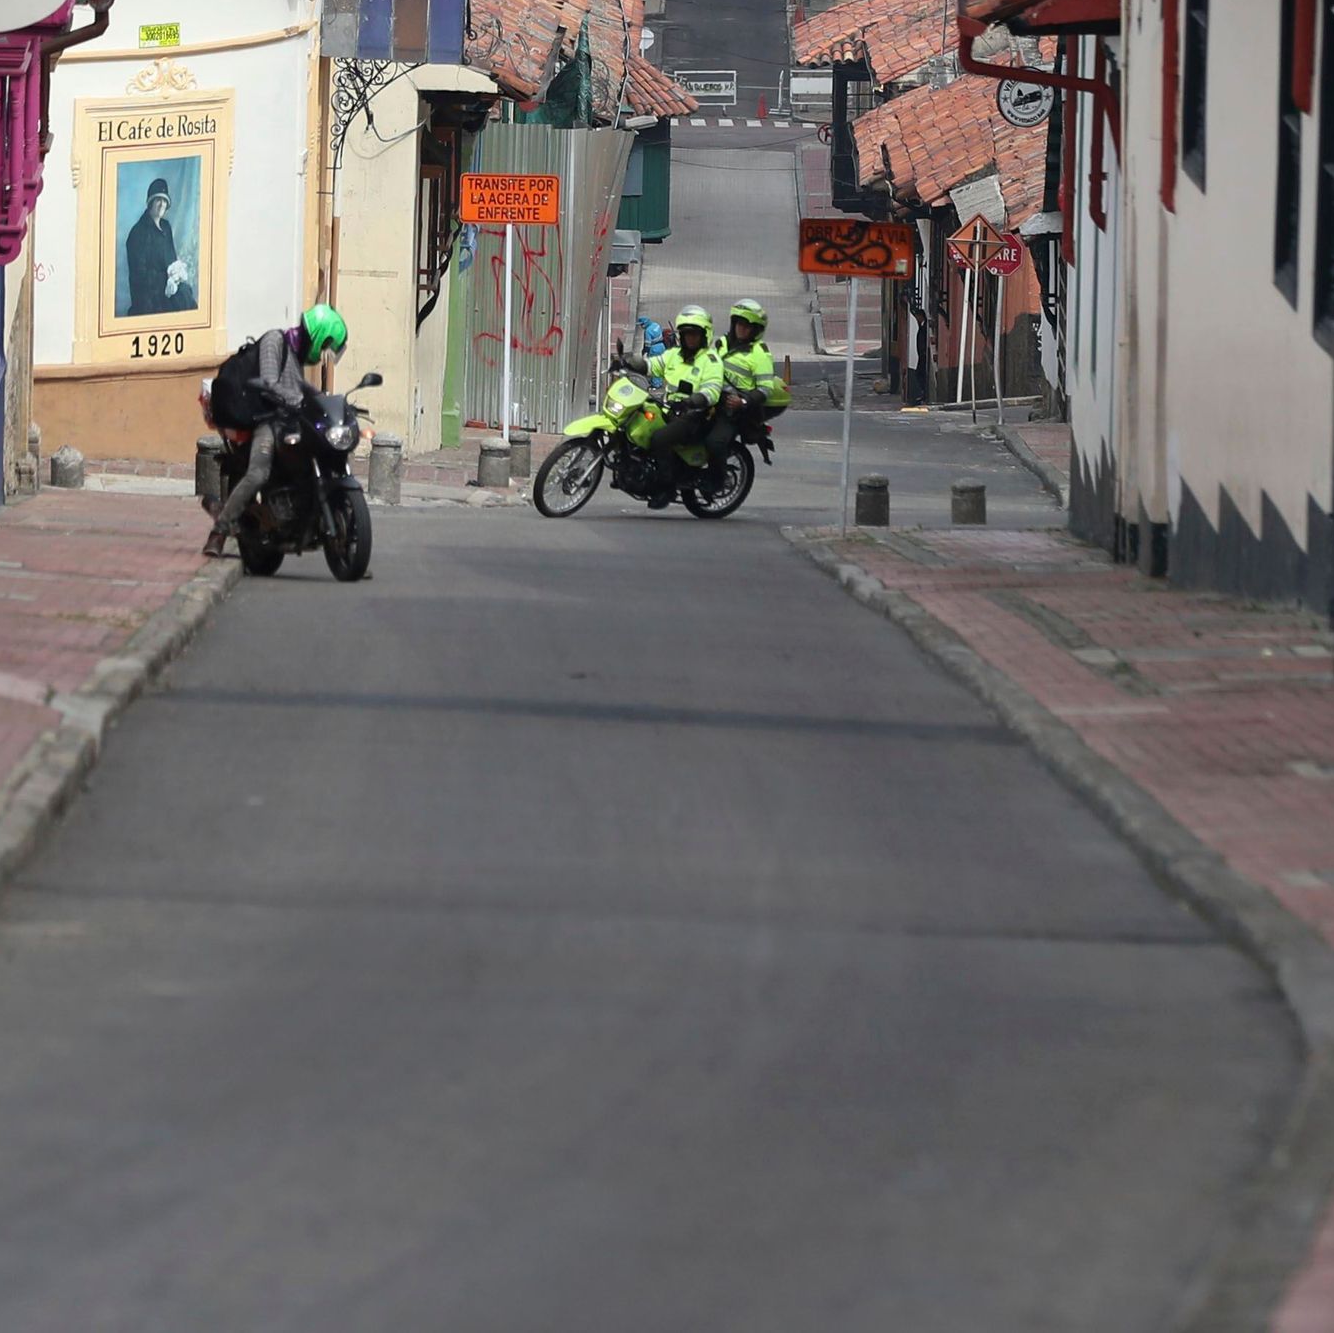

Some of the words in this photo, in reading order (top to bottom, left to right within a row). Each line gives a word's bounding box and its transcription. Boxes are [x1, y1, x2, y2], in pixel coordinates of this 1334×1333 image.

[98, 121, 113, 142] El
[117, 118, 152, 140] Café
[156, 117, 174, 138] de
[178, 114, 216, 136] Rosita
[468, 178, 525, 191] TRANSITE
[529, 180, 553, 191] POR
[471, 193, 485, 205] LA
[489, 193, 529, 206] ACERA
[533, 194, 549, 206] DE
[478, 207, 540, 220] ENFRENTE
[806, 225, 844, 240] OBRA
[888, 229, 907, 243] VIA
[994, 247, 1017, 261] ARE
[131, 332, 184, 358] 1920
